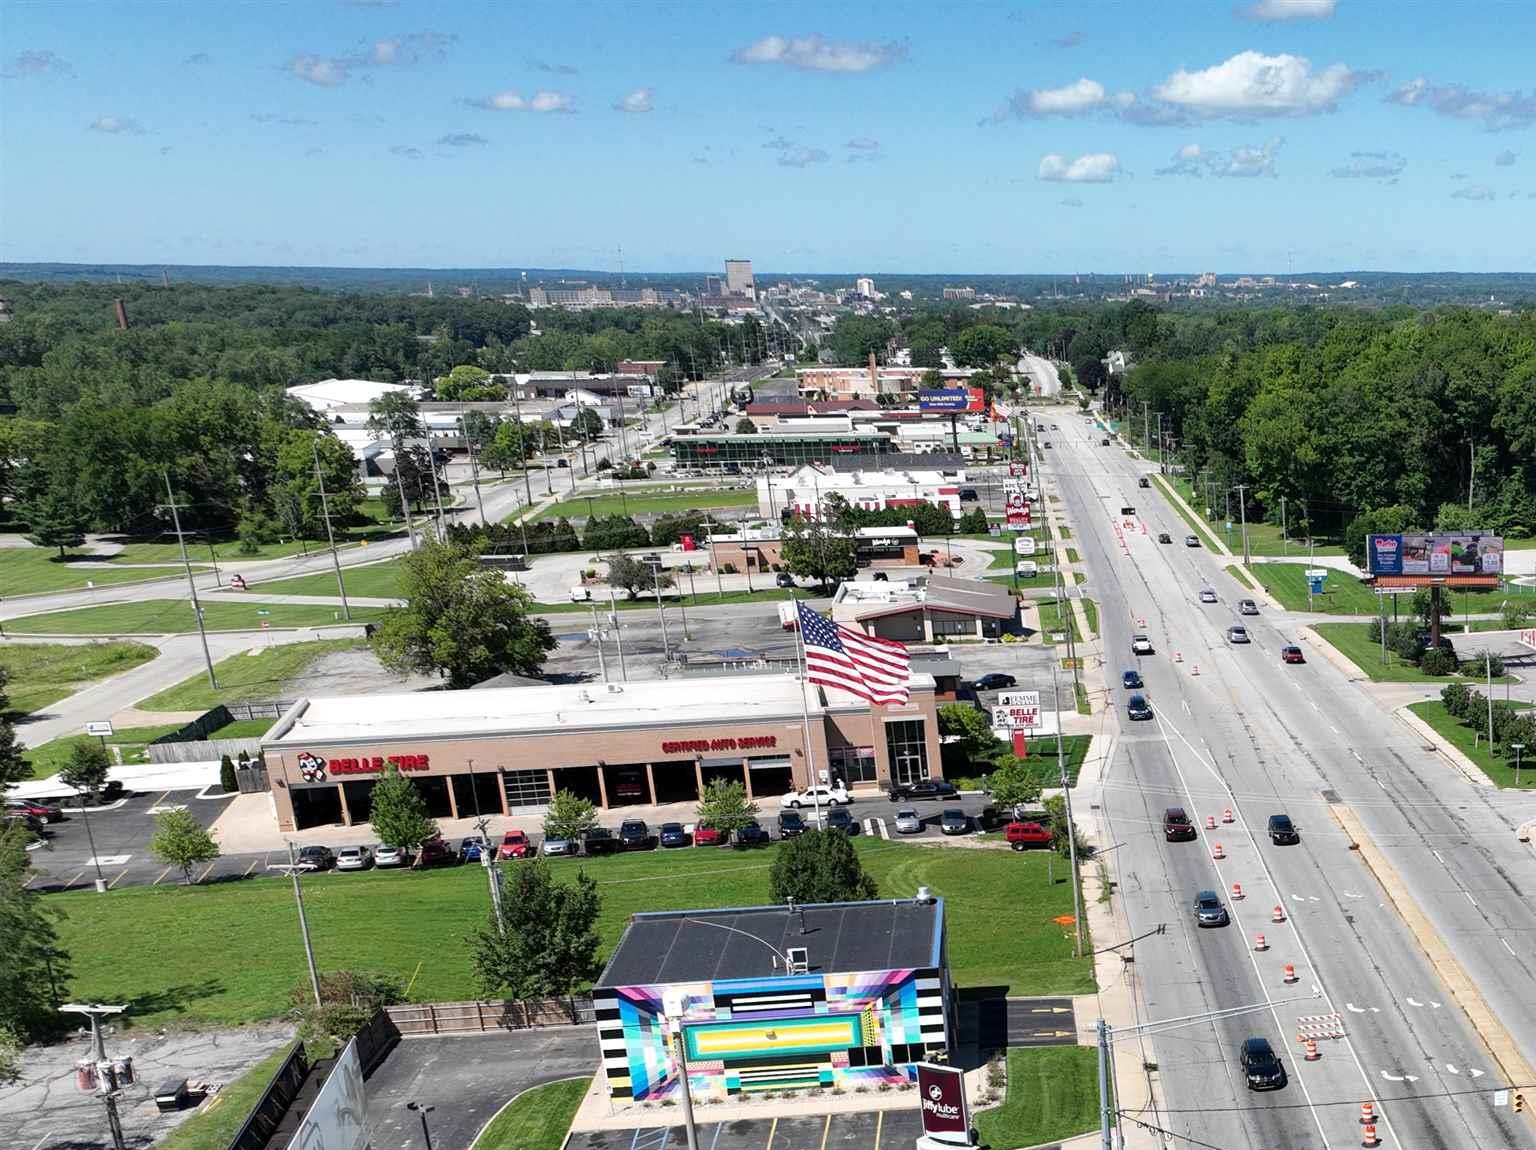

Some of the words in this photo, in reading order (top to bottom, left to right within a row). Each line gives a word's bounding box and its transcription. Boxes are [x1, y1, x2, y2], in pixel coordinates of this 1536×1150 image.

[1009, 708, 1038, 716] BELLE
[1013, 716, 1034, 724] TIRE
[329, 756, 385, 775] BELLE
